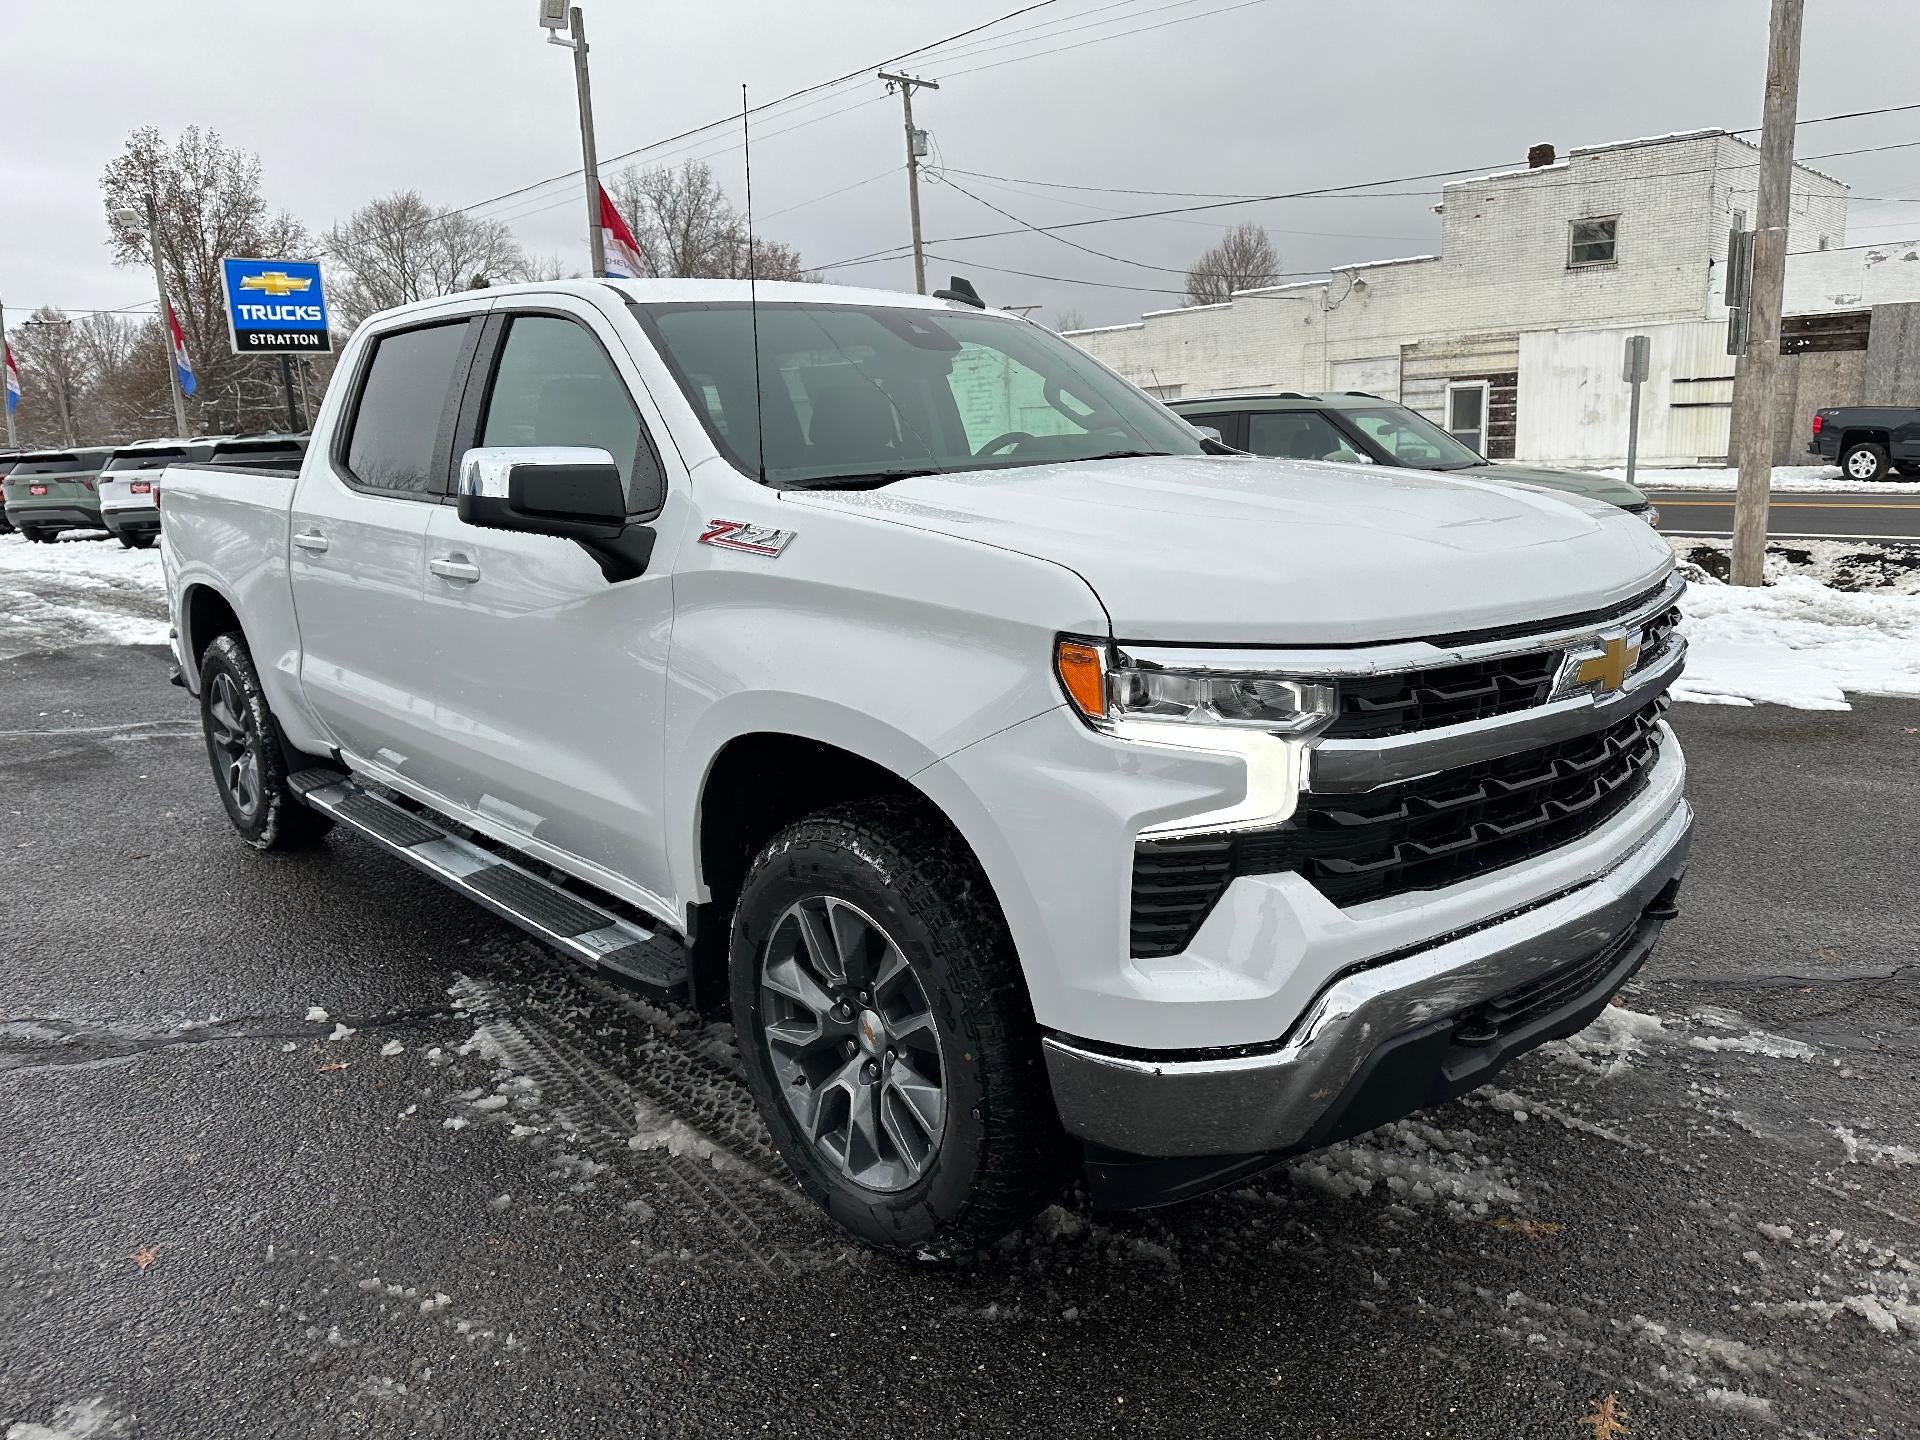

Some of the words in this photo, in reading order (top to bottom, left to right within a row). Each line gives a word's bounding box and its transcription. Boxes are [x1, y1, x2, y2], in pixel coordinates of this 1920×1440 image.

[237, 304, 322, 321] TRUCKS
[249, 333, 319, 345] STRATTON
[697, 517, 797, 559] Z71
